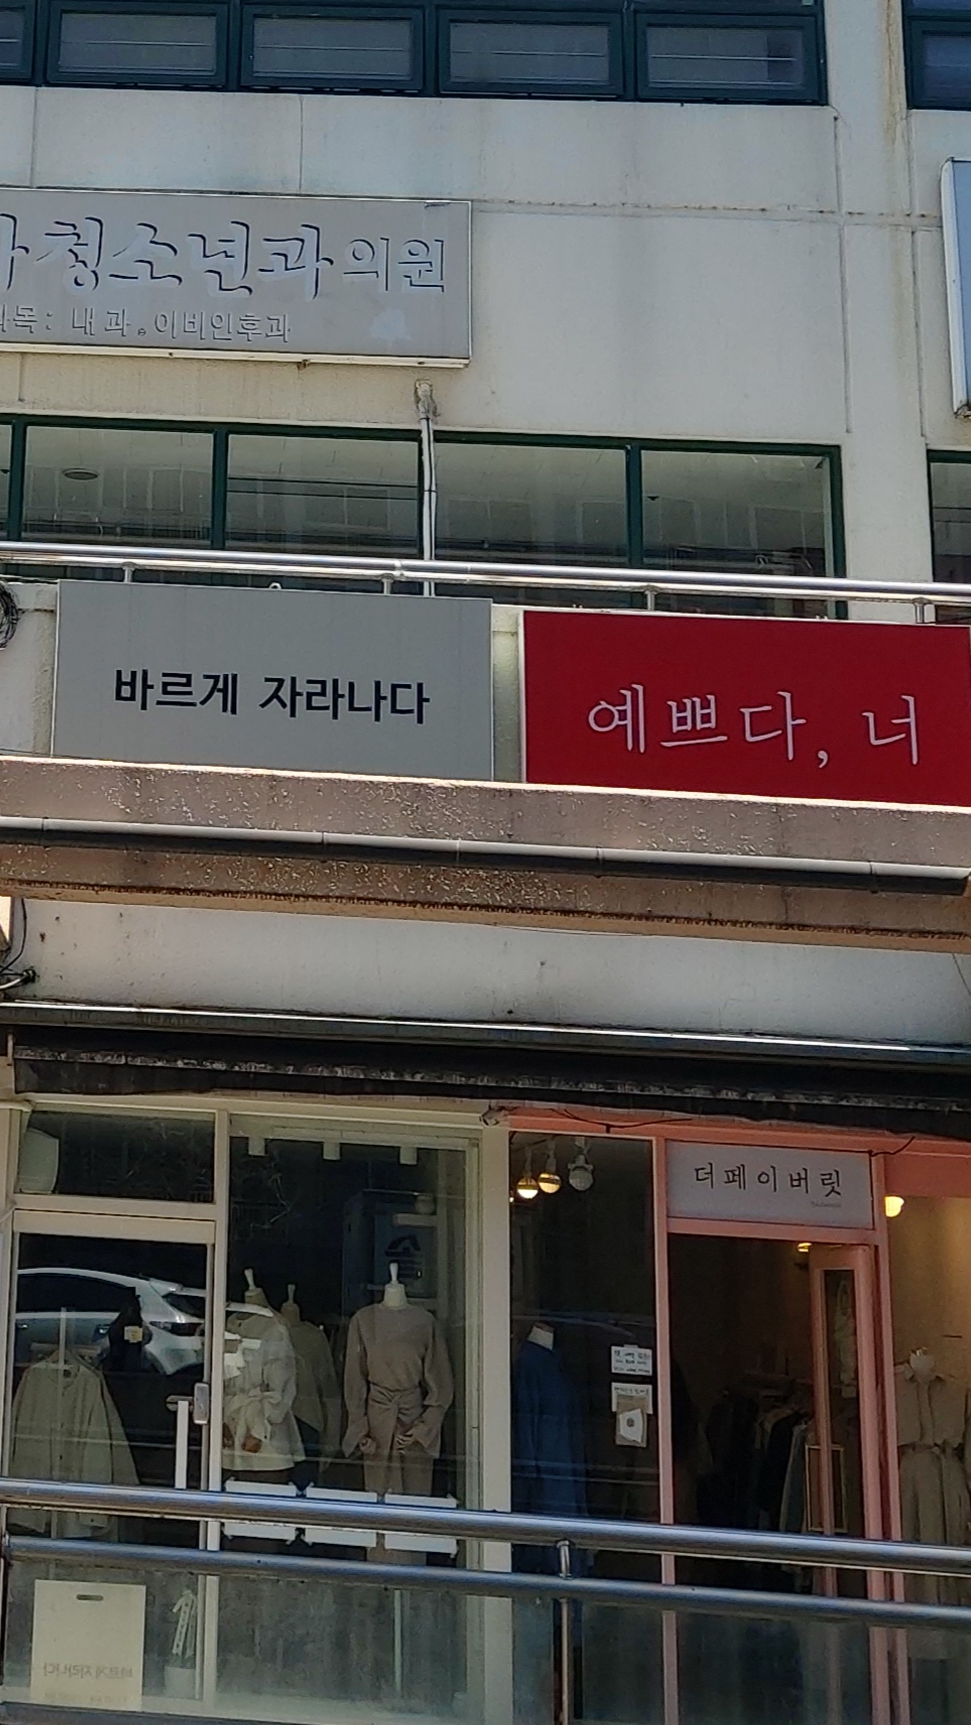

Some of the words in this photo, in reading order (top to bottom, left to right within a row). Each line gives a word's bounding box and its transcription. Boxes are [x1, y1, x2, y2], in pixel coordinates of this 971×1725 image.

[115, 668, 240, 717] 바르게
[259, 675, 432, 725] 자라나다
[589, 685, 830, 769] 예쁘다,
[862, 695, 921, 767] 너
